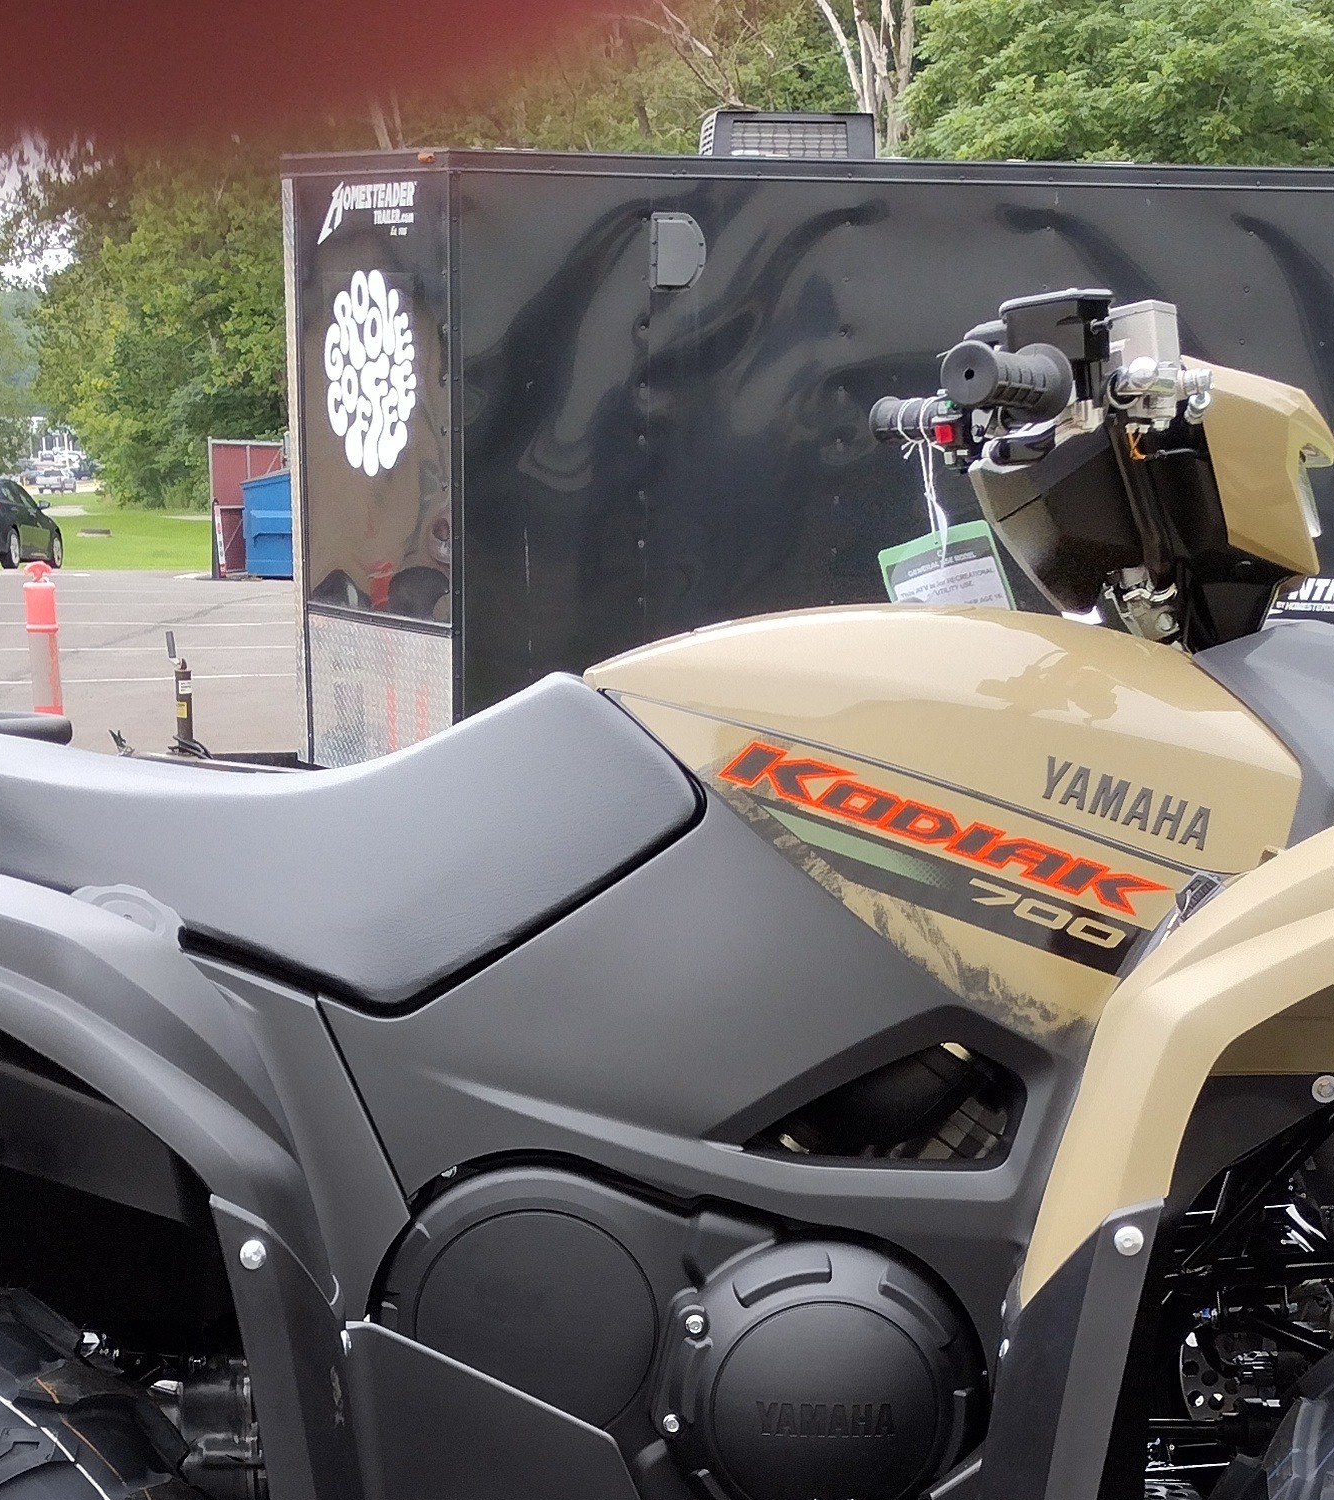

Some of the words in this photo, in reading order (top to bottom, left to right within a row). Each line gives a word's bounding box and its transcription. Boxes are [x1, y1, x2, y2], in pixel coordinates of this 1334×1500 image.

[317, 181, 414, 246] HOMESTEADER
[324, 269, 415, 382] GROOVE
[327, 352, 417, 477] COFFEE
[1041, 755, 1213, 852] YAMAHA
[967, 877, 1129, 950] 700
[755, 1400, 897, 1438] YAMAHA
